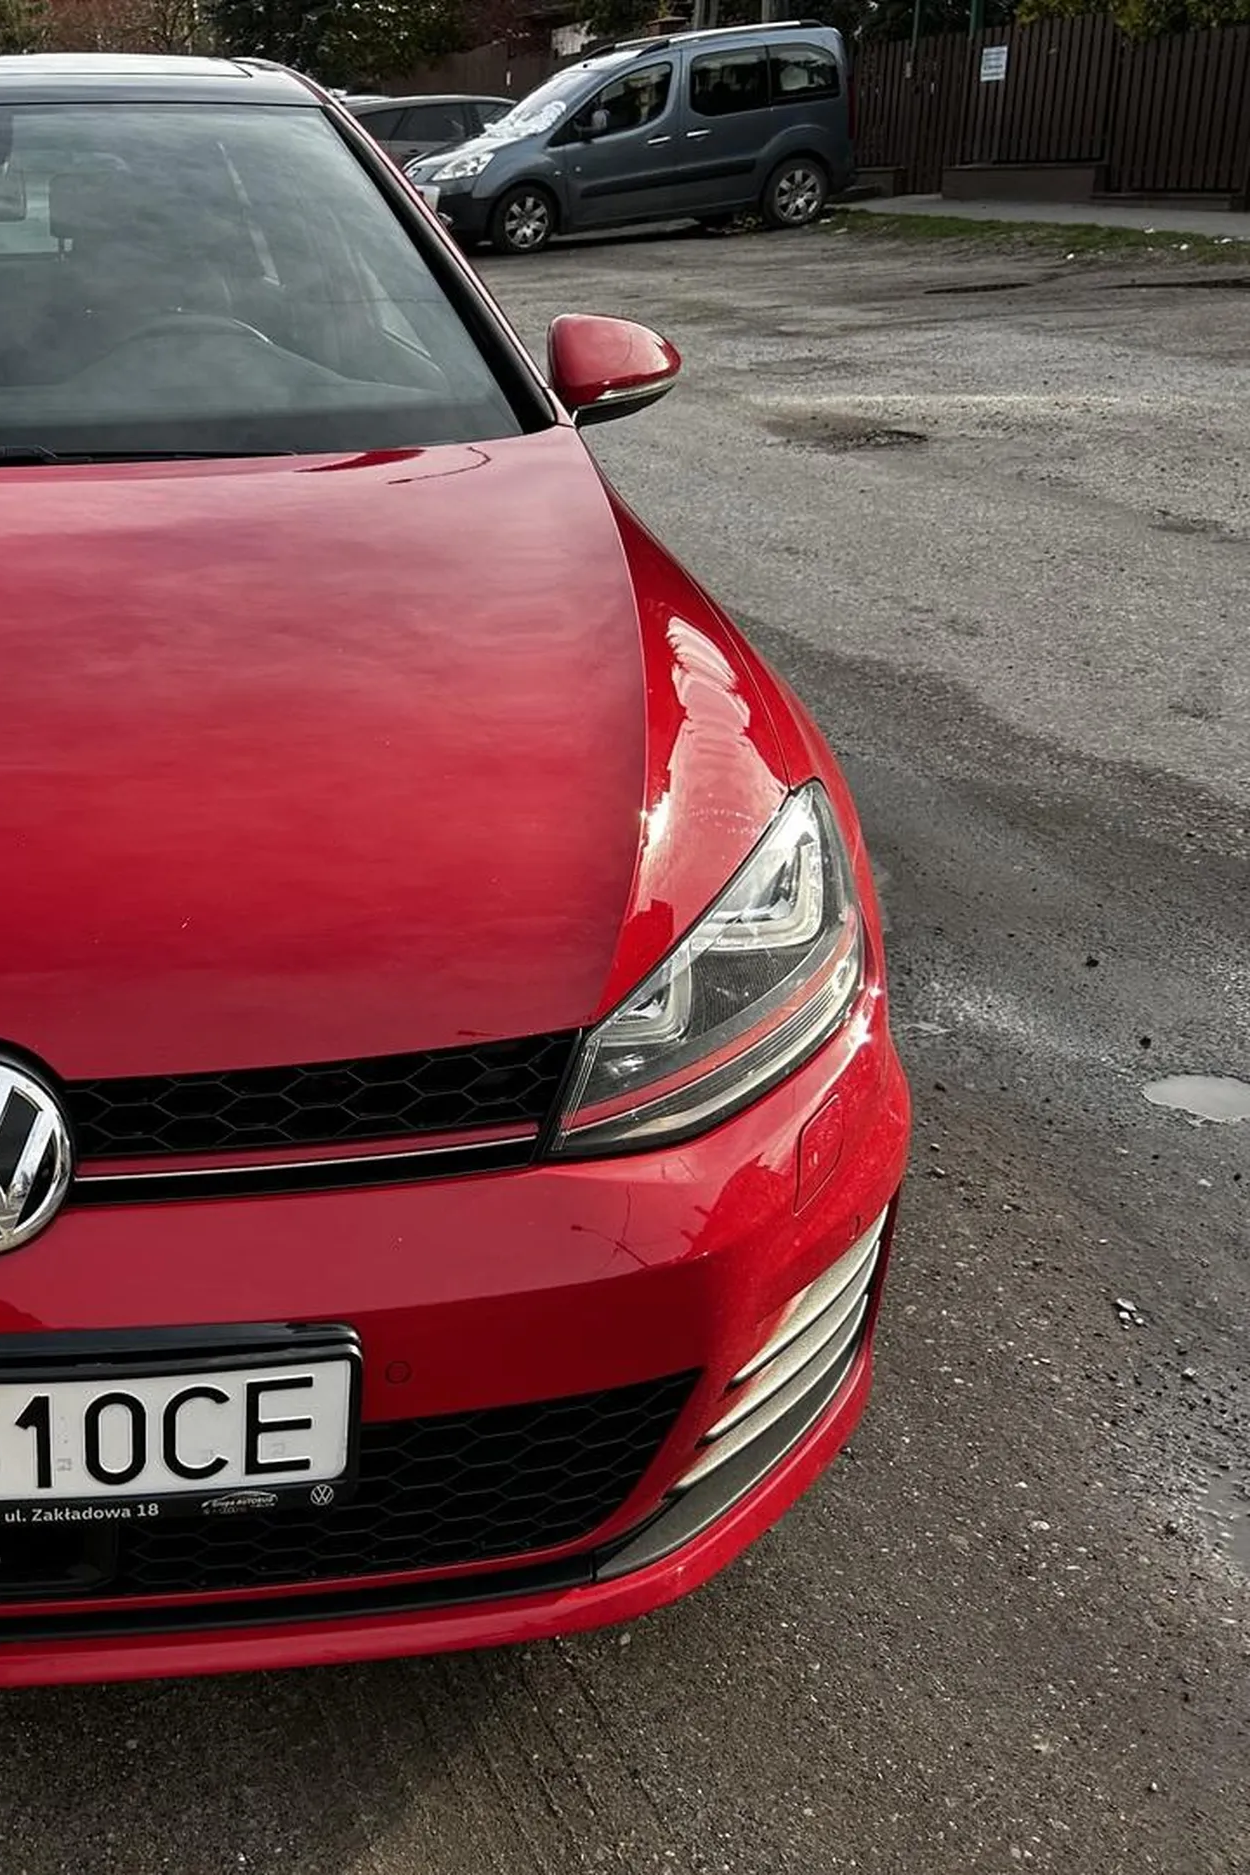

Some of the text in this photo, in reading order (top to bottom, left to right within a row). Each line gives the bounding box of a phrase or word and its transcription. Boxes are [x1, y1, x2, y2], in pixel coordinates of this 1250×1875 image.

[4, 1509, 27, 1522] ul.
[32, 1506, 131, 1522] Zakładowa
[137, 1503, 159, 1516] 18
